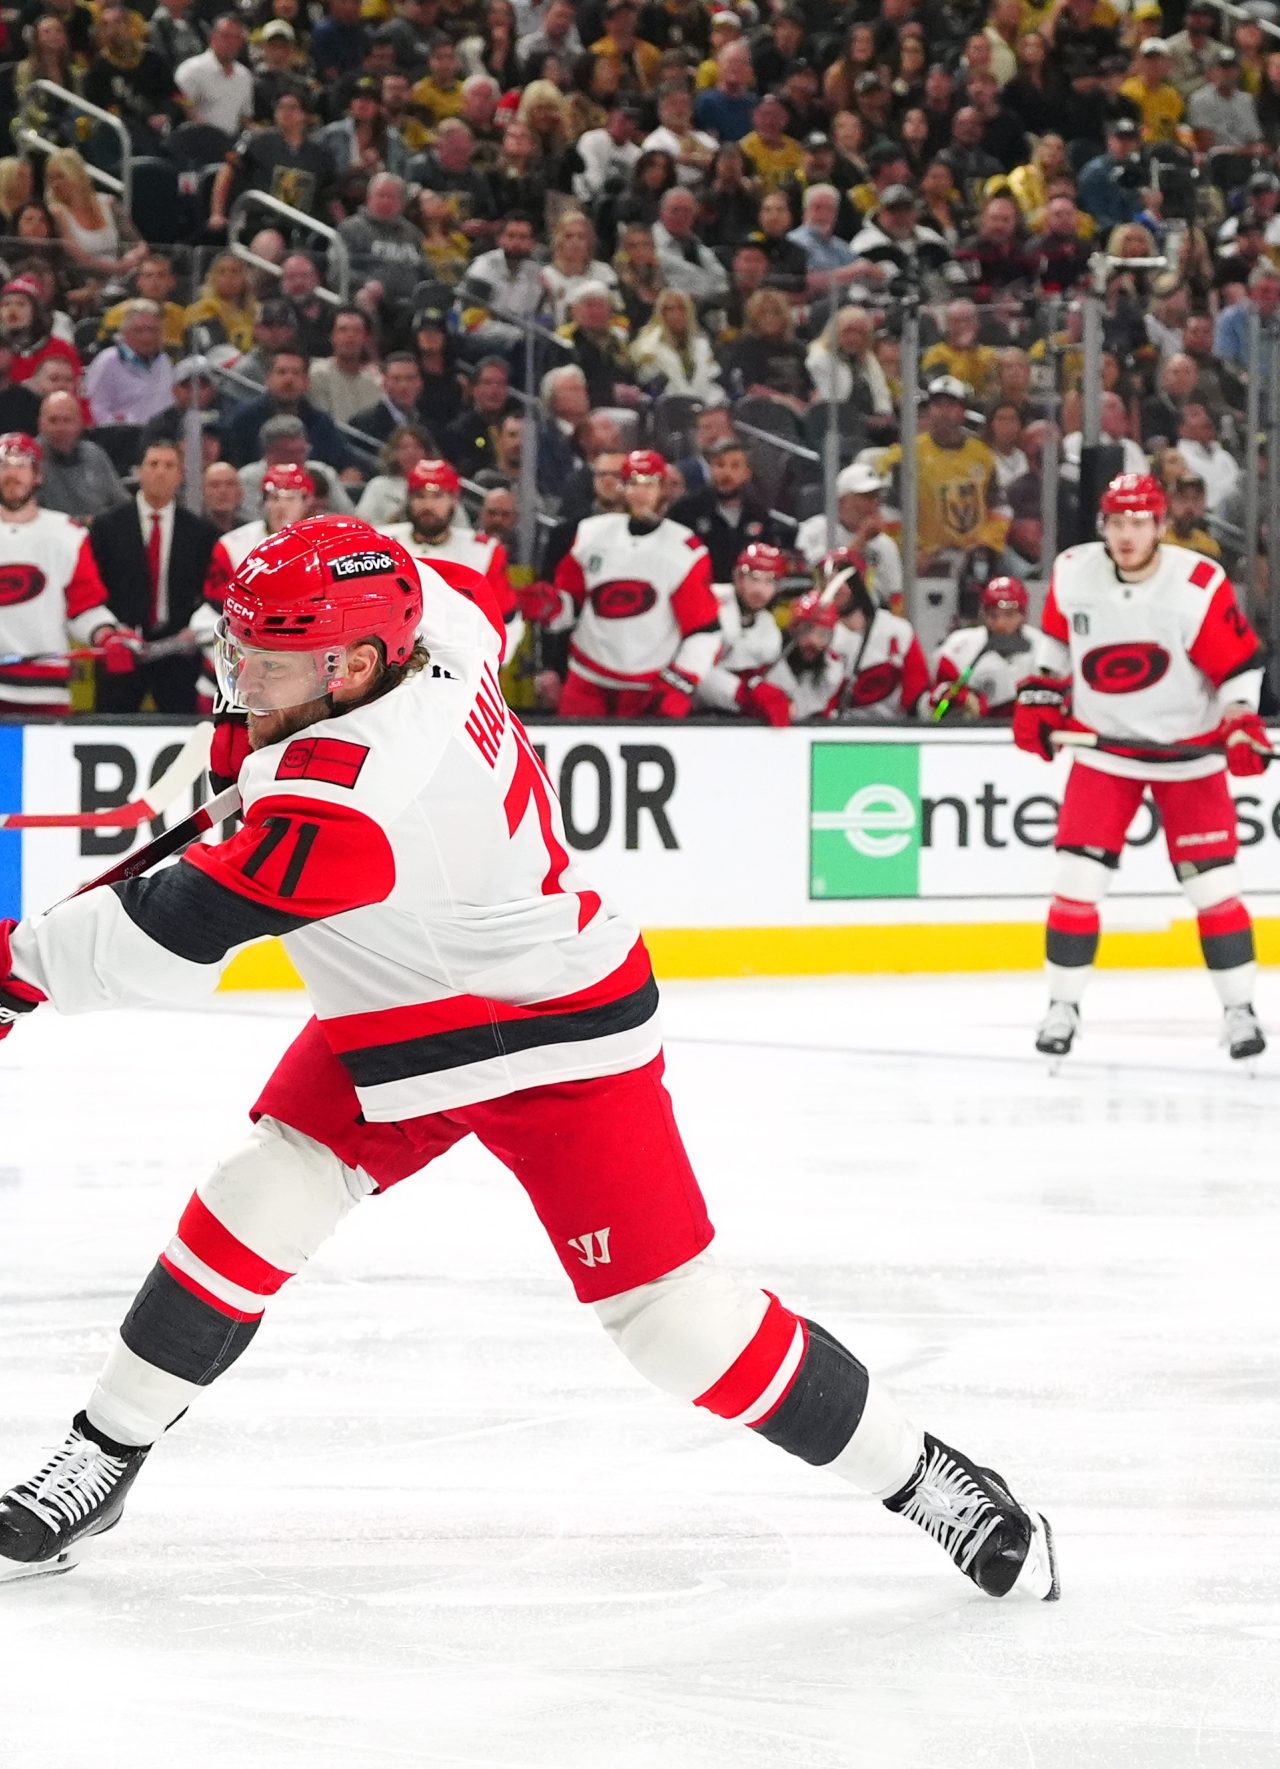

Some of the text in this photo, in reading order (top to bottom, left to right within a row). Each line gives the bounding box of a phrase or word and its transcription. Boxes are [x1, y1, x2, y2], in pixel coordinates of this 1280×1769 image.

[335, 556, 391, 575] Lenovo
[226, 597, 255, 620] CCM
[242, 816, 320, 898] 71
